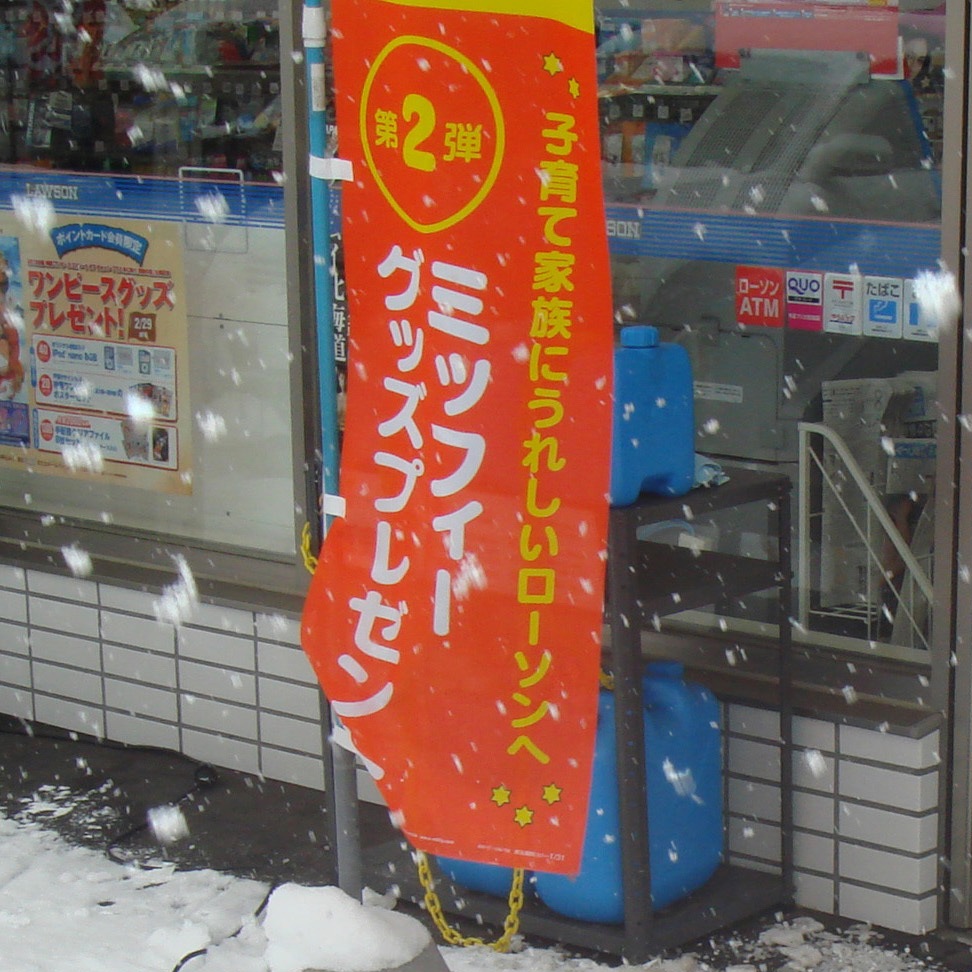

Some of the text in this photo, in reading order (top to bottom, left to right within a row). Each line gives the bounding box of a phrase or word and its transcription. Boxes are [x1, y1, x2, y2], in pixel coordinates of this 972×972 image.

[374, 93, 483, 172] 第2弾
[26, 182, 78, 200] LAWSON
[607, 219, 640, 239] SON
[28, 270, 174, 311] ワンピースグッズ
[739, 278, 780, 296] ローソン
[788, 278, 820, 295] QUO
[866, 282, 900, 298] たばこ
[740, 297, 779, 318] ATM
[428, 260, 492, 636] ミッフィー
[507, 112, 580, 764] 子育て家族にうれしいローソンへ
